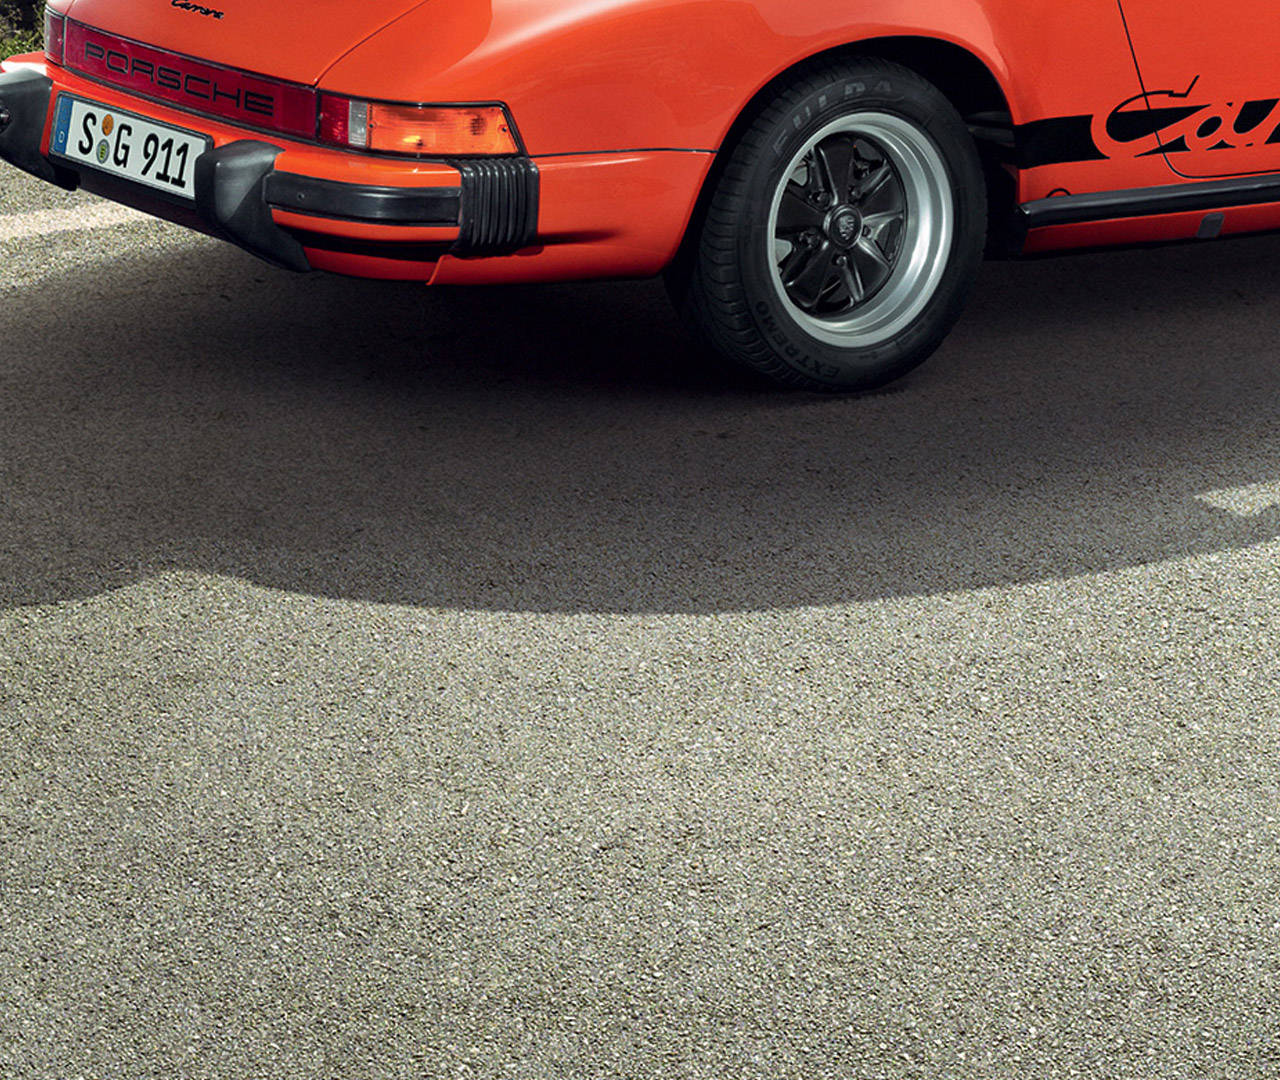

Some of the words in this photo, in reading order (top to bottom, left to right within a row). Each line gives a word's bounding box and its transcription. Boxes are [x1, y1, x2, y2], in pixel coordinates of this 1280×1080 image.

[84, 42, 274, 116] PORSCHE
[78, 111, 97, 155] S
[113, 123, 133, 168] G
[141, 133, 189, 188] 911
[755, 300, 841, 378] EXTREMO
